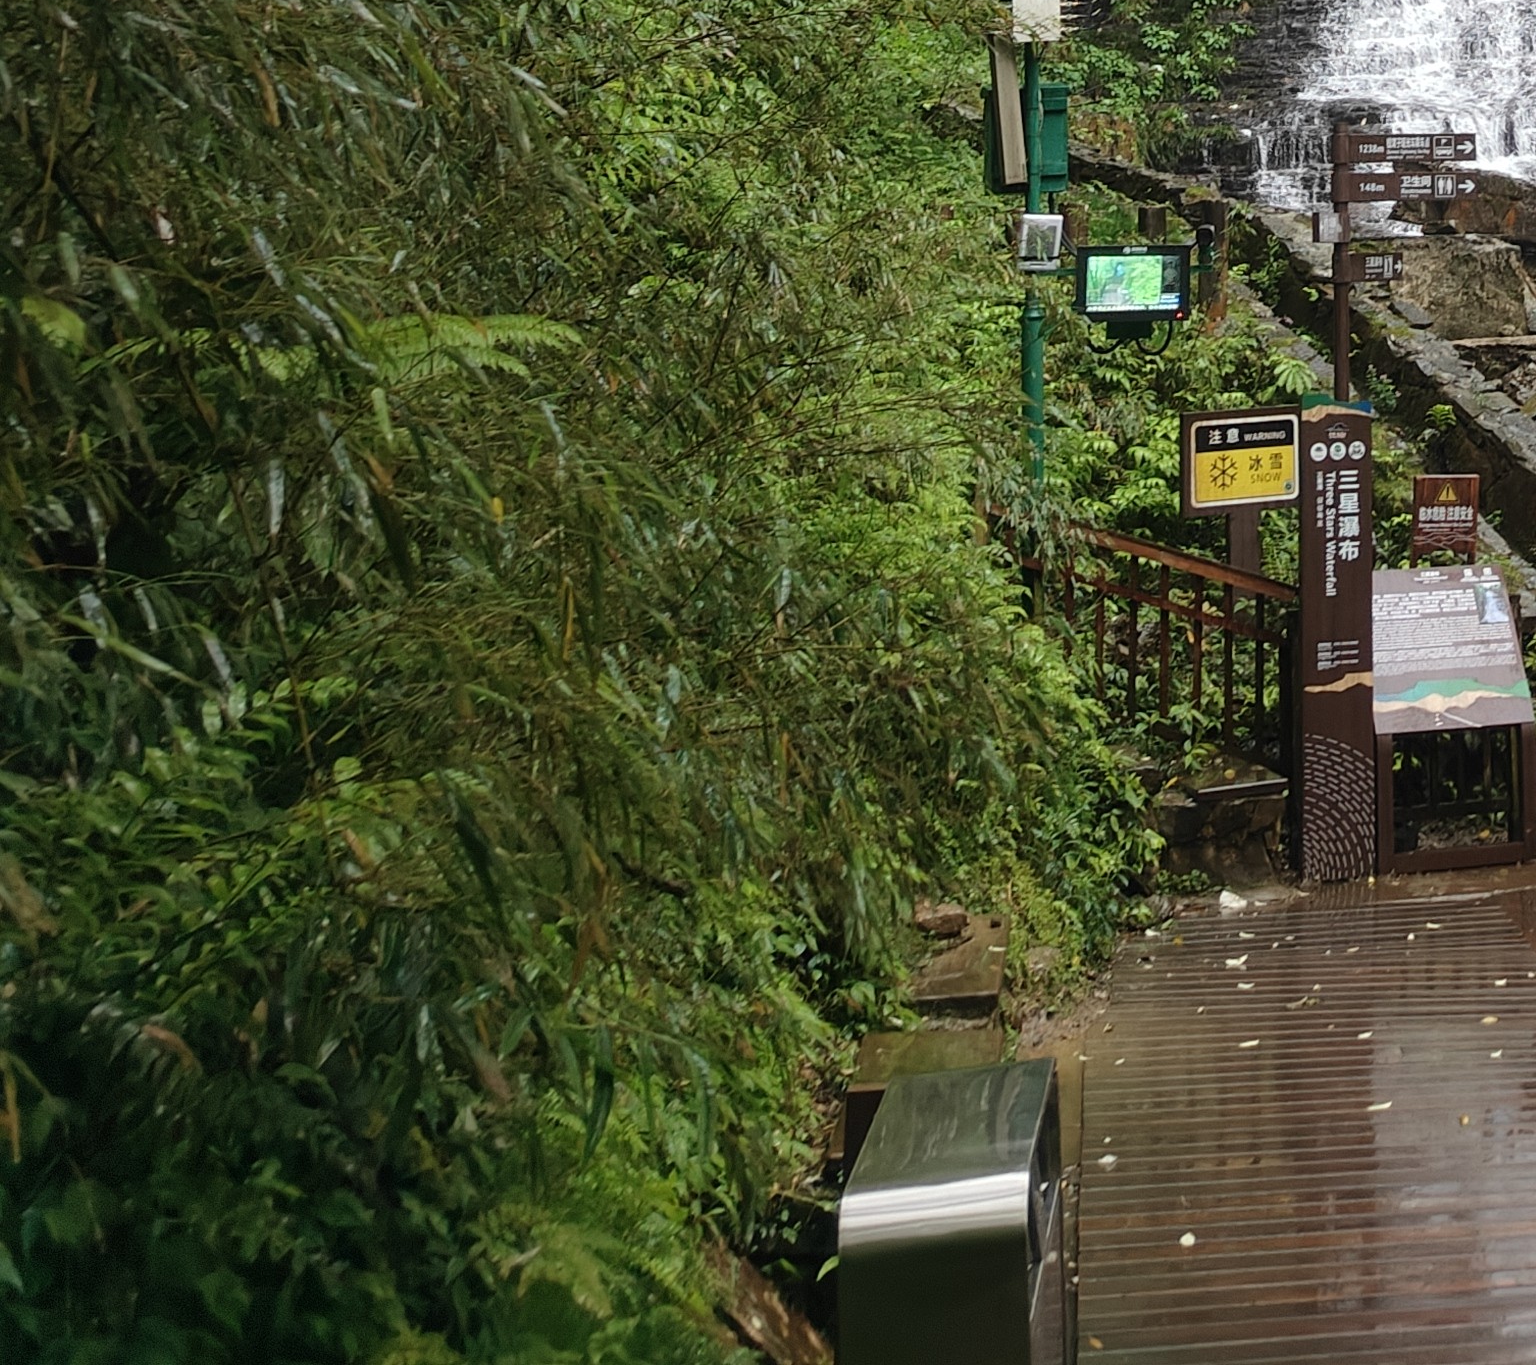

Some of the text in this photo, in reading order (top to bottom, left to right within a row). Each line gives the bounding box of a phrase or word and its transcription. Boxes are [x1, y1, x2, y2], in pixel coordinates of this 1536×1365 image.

[1400, 175, 1432, 187] 卫生间
[1208, 428, 1239, 445] 注意
[1243, 431, 1286, 441] WARNING
[1249, 452, 1283, 471] 冰雪
[1251, 472, 1282, 484] SNOW
[1338, 470, 1360, 561] 三星瀑布
[1325, 470, 1337, 596] Three Stars Waterfall
